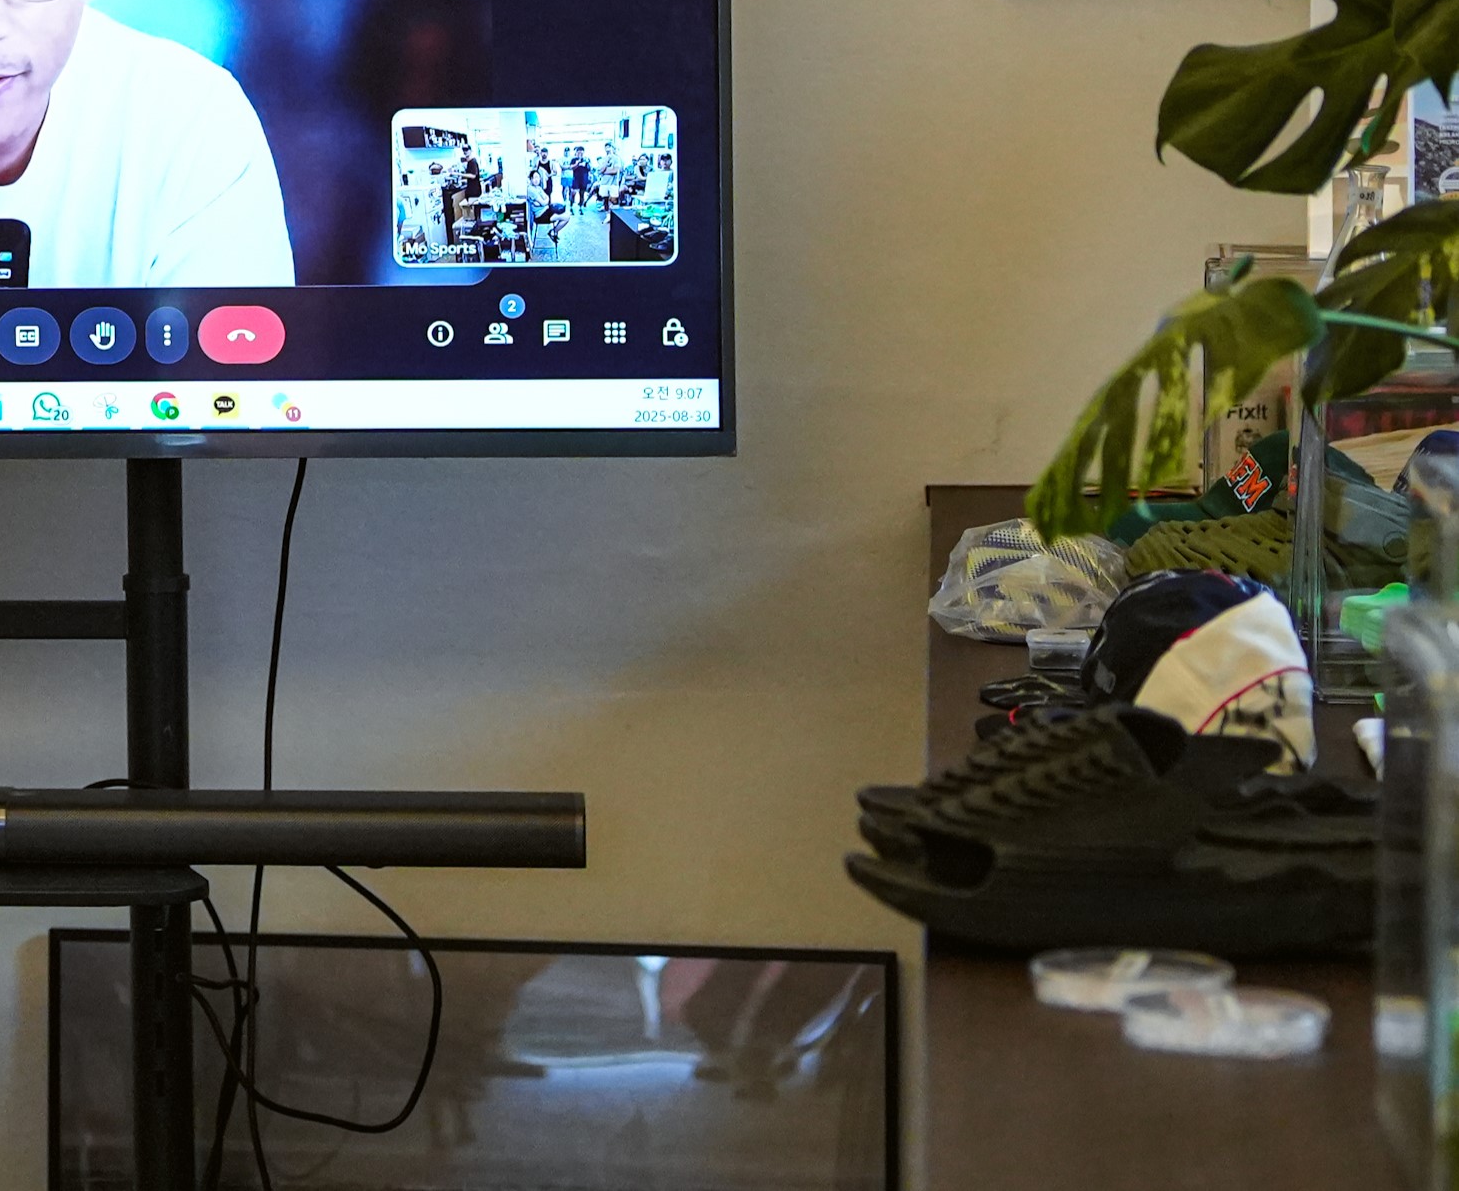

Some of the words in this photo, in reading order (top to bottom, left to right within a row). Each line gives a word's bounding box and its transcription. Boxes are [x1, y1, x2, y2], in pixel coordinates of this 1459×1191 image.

[405, 242, 428, 255] Mo
[430, 242, 477, 258] Sports
[507, 299, 517, 312] 2
[642, 386, 670, 401] 오전
[675, 387, 703, 400] 9:07
[215, 400, 234, 409] TALK
[53, 409, 70, 421] 20
[287, 409, 299, 419] 11
[634, 410, 711, 422] 2025-08-30
